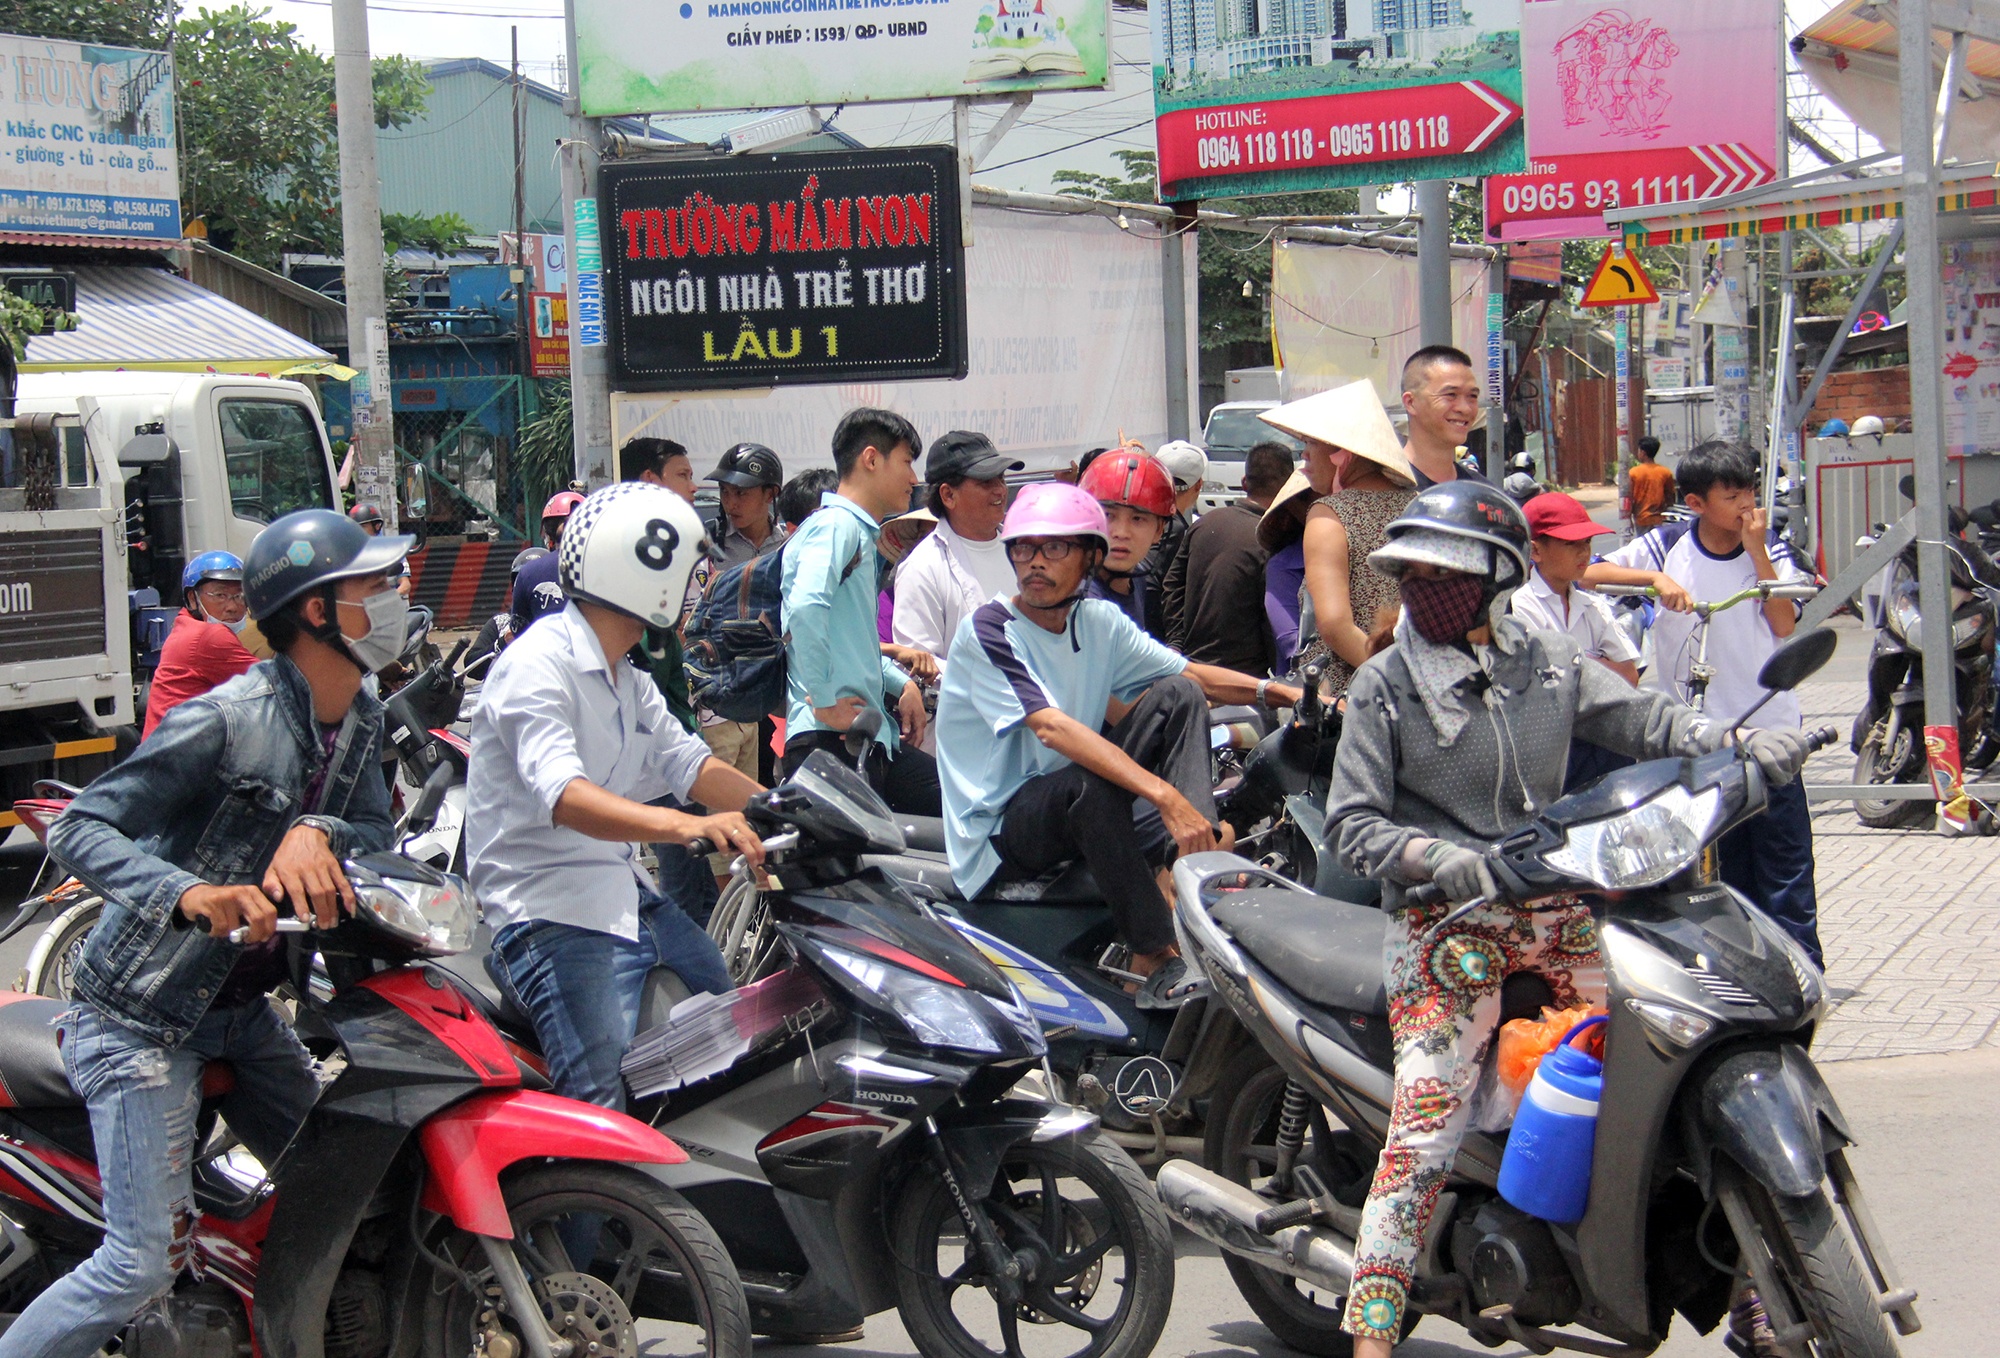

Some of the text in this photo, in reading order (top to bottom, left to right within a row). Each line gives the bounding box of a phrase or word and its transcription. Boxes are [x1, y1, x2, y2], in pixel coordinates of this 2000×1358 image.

[708, 0, 949, 17] MAMNONNGOINHATRETHO..
[727, 22, 761, 47] GIẤY
[766, 24, 801, 45] PHÉP
[888, 21, 928, 37] UBND
[14, 46, 119, 111] HÙNG
[6, 119, 166, 150] khắc CNC vách ngăn
[1195, 109, 1267, 131] HOTLINE:
[16, 145, 65, 166] giường
[79, 147, 94, 166] tủ
[109, 150, 133, 169] cửa
[1197, 135, 1240, 169] 0964
[1244, 131, 1276, 164] 118
[1281, 128, 1313, 161] 118
[1330, 123, 1373, 158] 0965
[1378, 119, 1411, 153] 118
[1415, 115, 1449, 149] 118
[1502, 161, 1556, 177] line
[46, 196, 106, 213] 091.878.1996
[113, 201, 171, 218] 094.598.4475
[1503, 174, 1695, 213] 0965 93 1111
[19, 213, 154, 233] cncviethung@gmail.com
[621, 191, 761, 260] TRƯỜNG
[855, 192, 932, 249] NON
[629, 257, 926, 316] NGÔI NHÀ TRẺ THƠ
[577, 274, 602, 345] 0945 600 500
[702, 314, 838, 363] LẦU 1
[635, 518, 680, 571] 8
[250, 556, 290, 590] PIAGGIO
[1687, 888, 1727, 903] HOND
[855, 1090, 919, 1105] HONDA
[943, 1168, 976, 1234] HONDA
